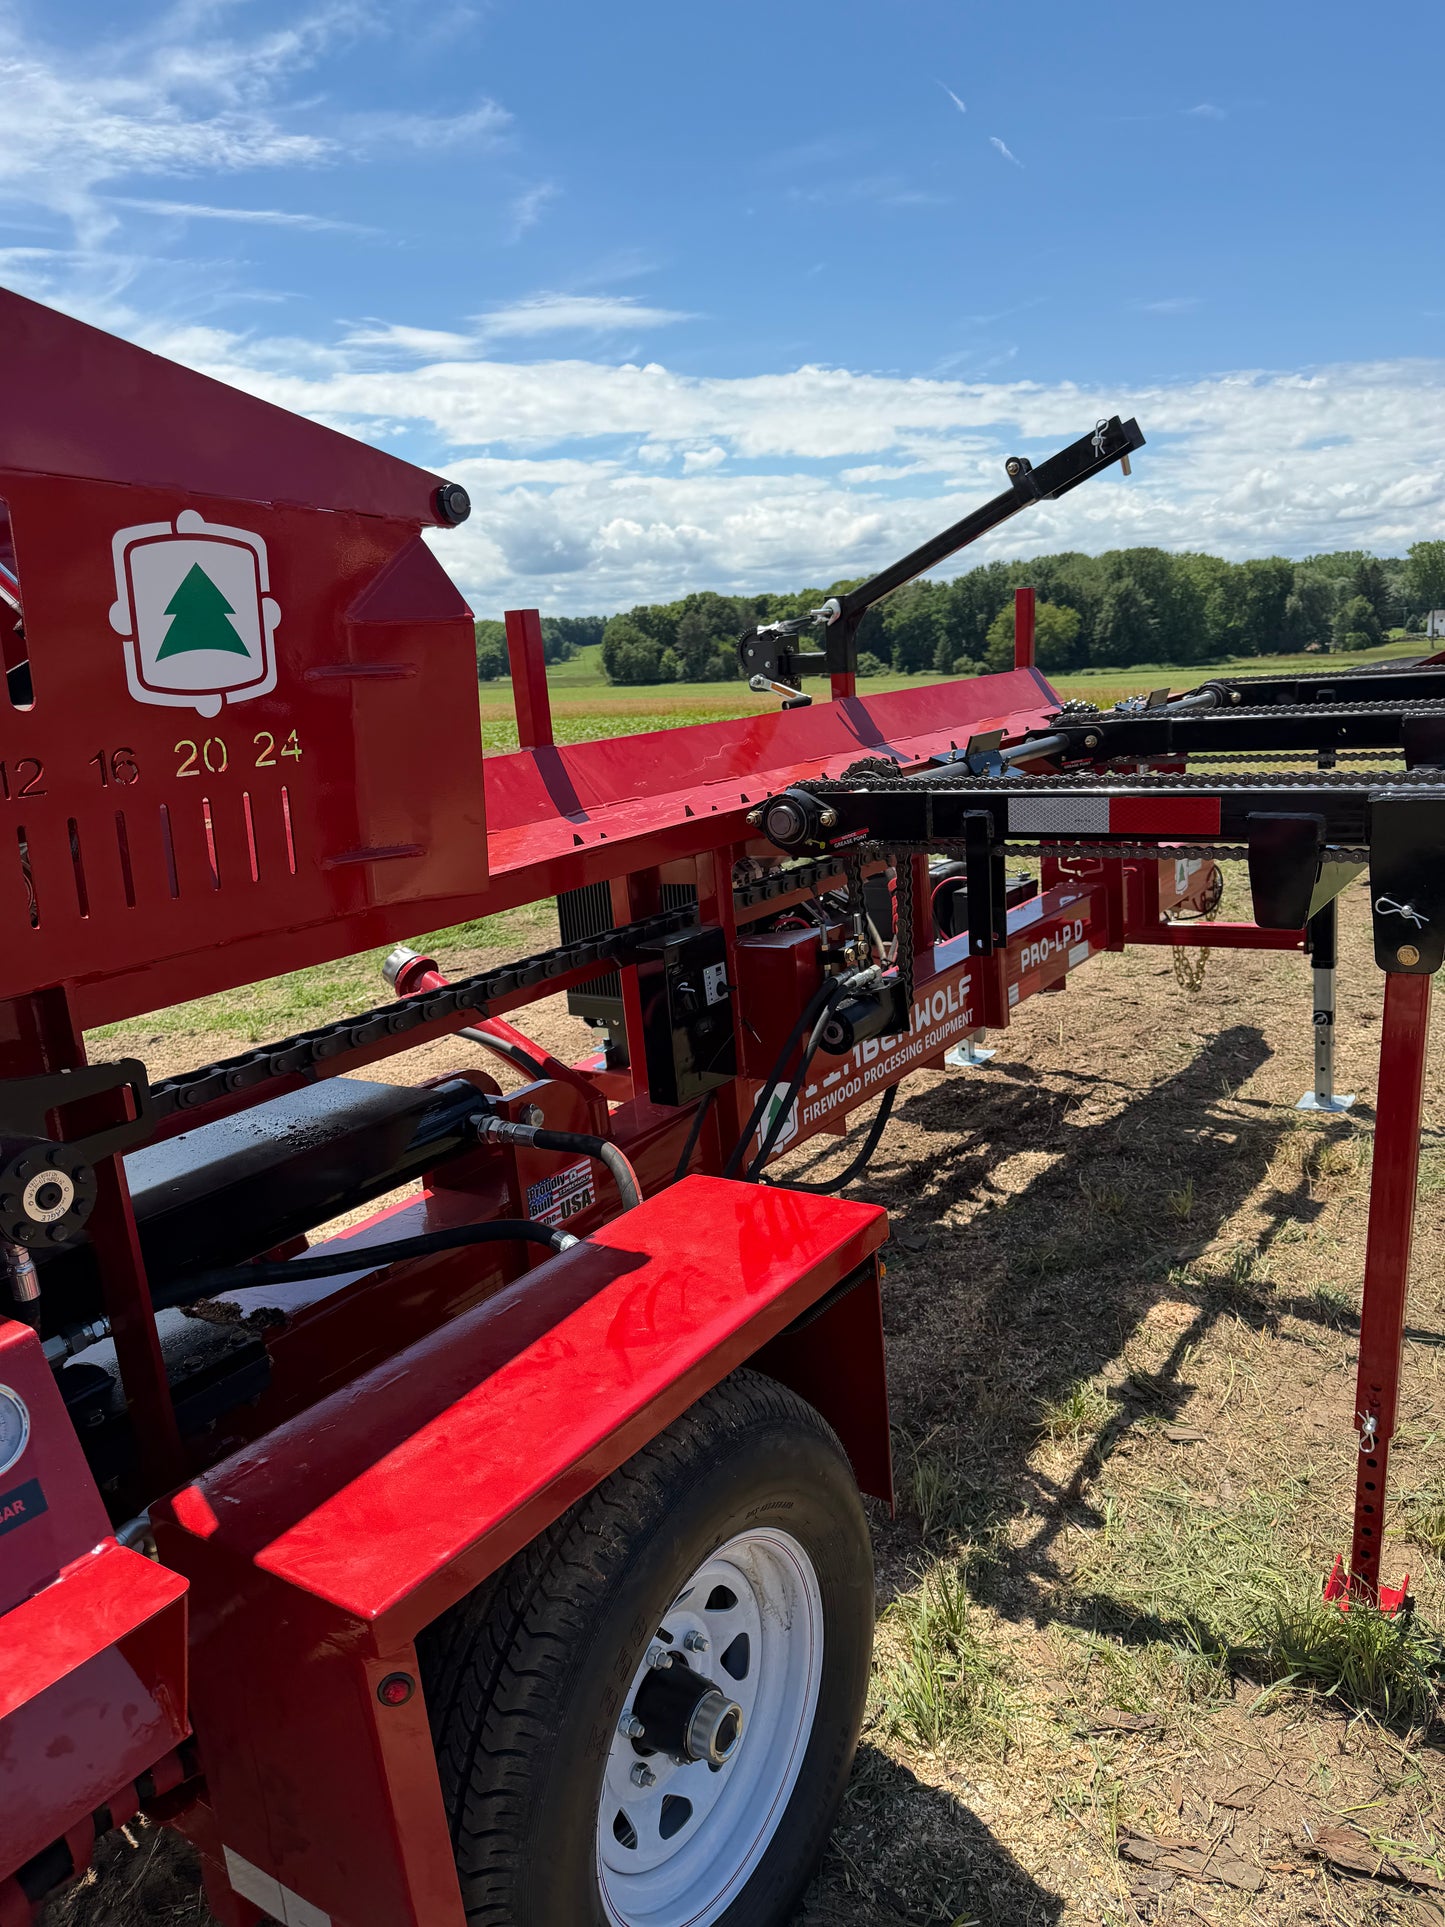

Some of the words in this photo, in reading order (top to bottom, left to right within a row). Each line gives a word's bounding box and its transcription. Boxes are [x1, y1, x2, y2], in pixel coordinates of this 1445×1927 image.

[0, 758, 48, 801] 12
[89, 748, 140, 788] 16
[174, 737, 229, 778] 20
[253, 729, 303, 767] 24
[834, 839, 853, 848] GREASE
[853, 834, 867, 842] POINT
[803, 1077, 862, 1125] FIREWOOD
[864, 1039, 923, 1087] PROCESSING
[924, 1008, 974, 1048] EQUIPMENT
[528, 1174, 566, 1200] Proudly
[40, 1206, 66, 1221] EAGLE
[531, 1196, 554, 1217] Built
[560, 1188, 592, 1219] USA
